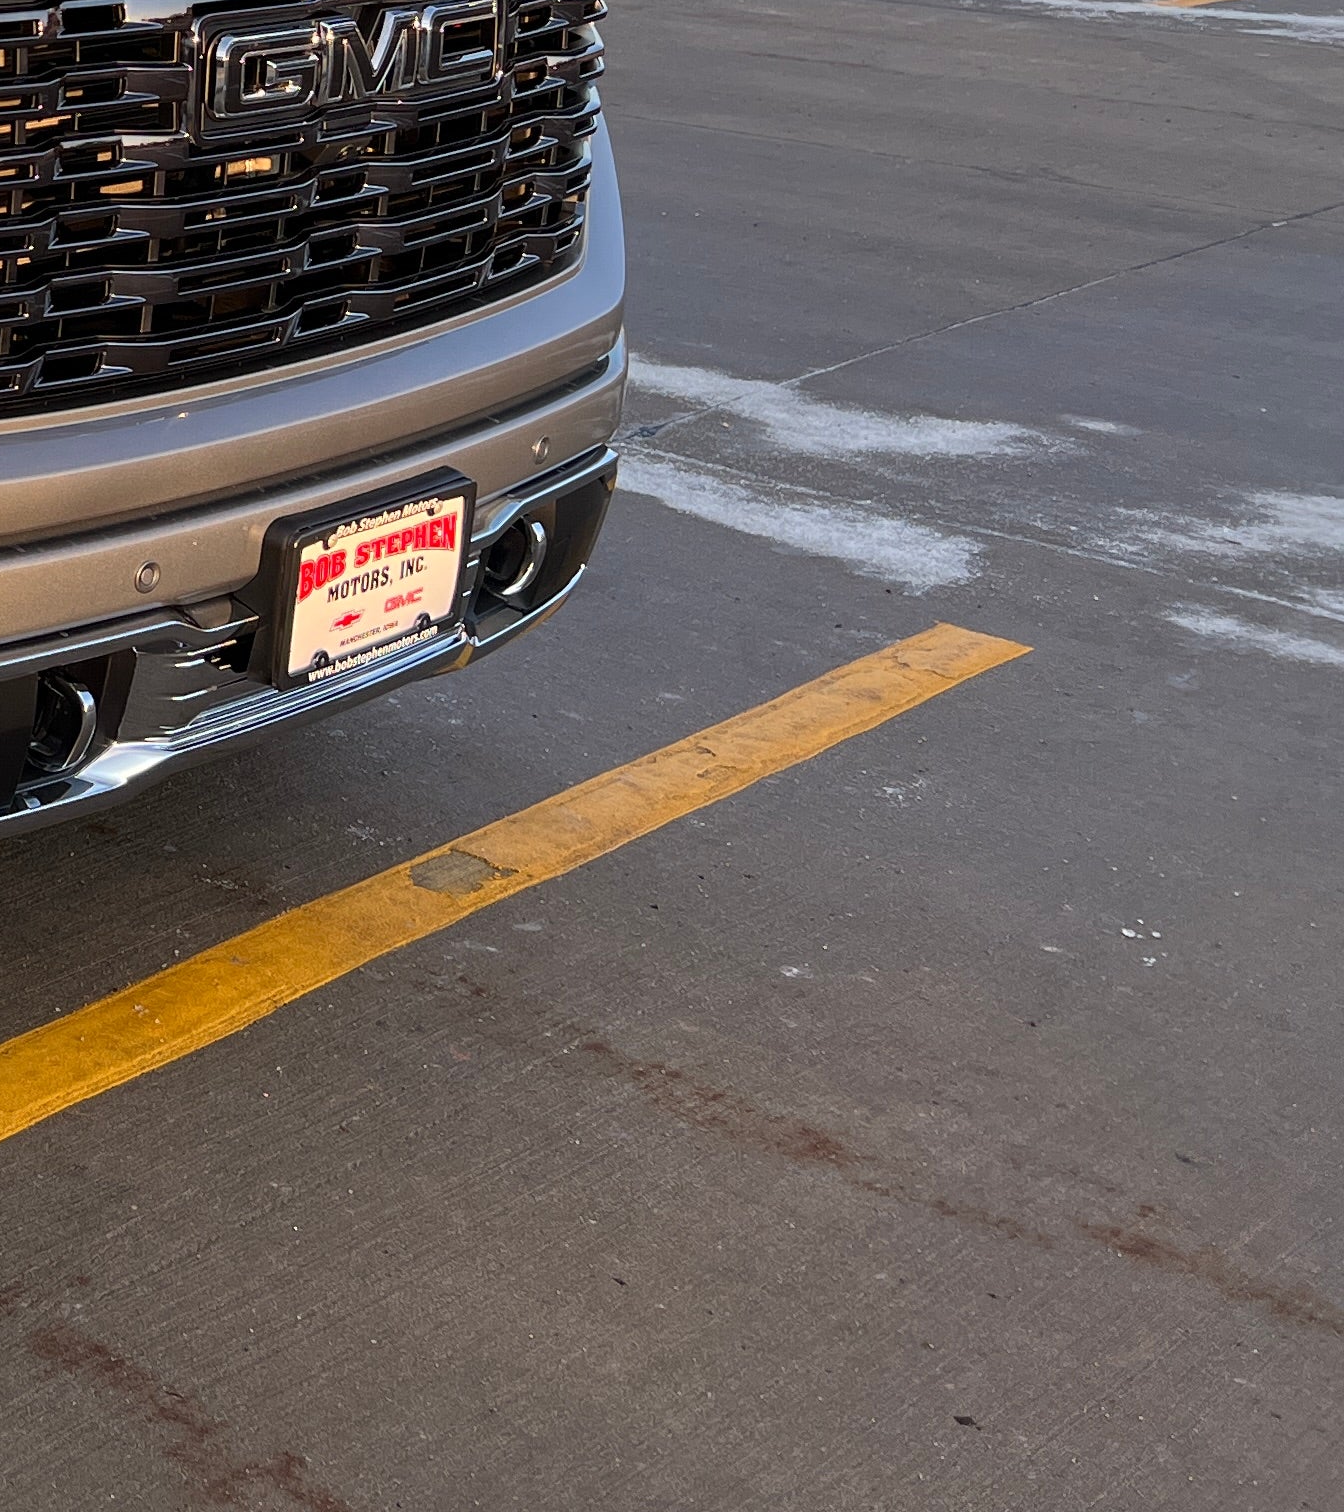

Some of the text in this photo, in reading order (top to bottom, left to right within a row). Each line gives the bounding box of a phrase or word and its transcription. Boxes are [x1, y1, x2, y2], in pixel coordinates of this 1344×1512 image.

[336, 498, 439, 540] Bob Stephen Motors
[297, 512, 457, 604] BOB STEPHEN
[327, 556, 428, 603] MOTORS, INC.
[384, 586, 424, 614] GMC
[308, 625, 439, 683] www.bobstephenmotors.com
